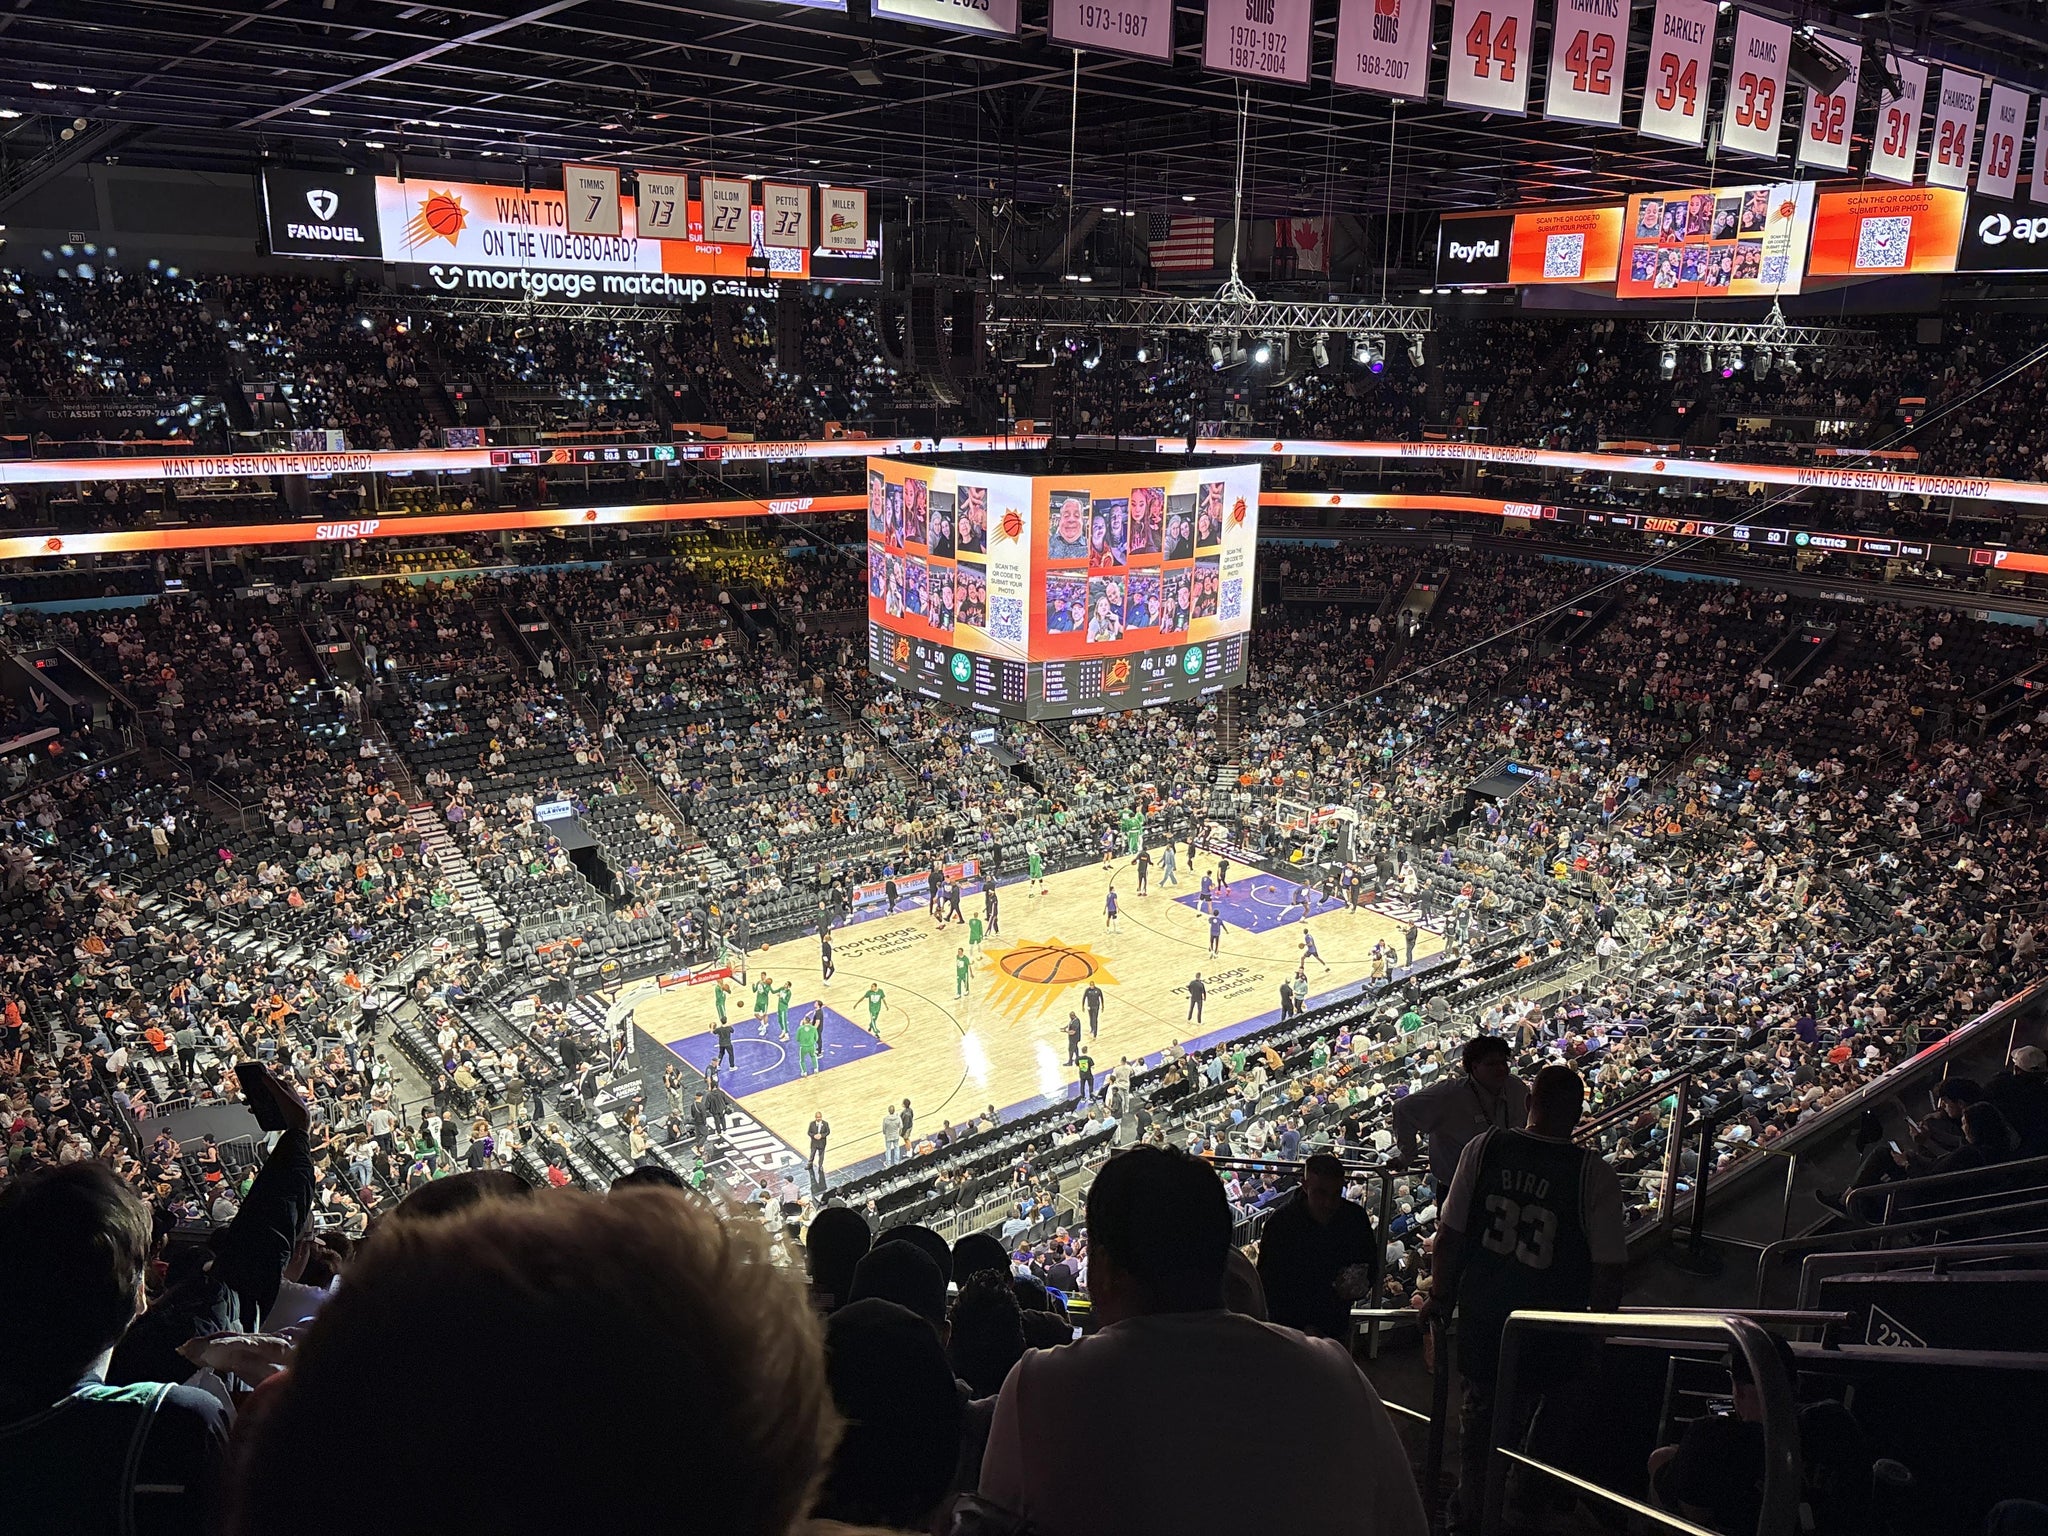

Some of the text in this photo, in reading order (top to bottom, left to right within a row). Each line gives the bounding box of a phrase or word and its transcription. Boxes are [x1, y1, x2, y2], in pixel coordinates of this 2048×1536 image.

[1078, 4, 1148, 37] 1973-1987
[1663, 13, 1706, 45] BARKLEY
[1230, 25, 1287, 54] 1970-1972
[1466, 10, 1518, 82] 44
[1748, 37, 1777, 63] ADAMS
[1229, 46, 1285, 74] 1987-2004
[1356, 52, 1409, 80] 1968-2007
[1565, 29, 1615, 95] 42
[1655, 51, 1698, 117] 34
[1735, 71, 1776, 132] 33
[1942, 88, 1975, 113] CHAMBERS
[1811, 93, 1847, 145] 32
[1999, 105, 2016, 124] NASH
[1883, 107, 1911, 159] 31
[1938, 119, 1967, 168] 24
[1987, 132, 2014, 179] 13
[579, 178, 605, 190] TIMMS
[648, 184, 675, 196] TAYLOR
[713, 190, 740, 202] GILLOM
[775, 195, 799, 207] PETTIS
[832, 199, 856, 210] MILLER
[1847, 195, 1869, 205] SCAN
[1870, 195, 1885, 204] THE
[1899, 194, 1921, 202] CODE
[1923, 193, 1934, 201] TO
[495, 197, 564, 227] WANT TO
[585, 195, 602, 222] 7
[649, 200, 675, 227] 13
[711, 206, 742, 232] 22
[1848, 203, 1929, 215] SUBMIT YOUR PHOTO
[287, 223, 365, 242] FANDUEL
[771, 210, 802, 236] 32
[483, 229, 638, 263] ON THE VIDEOBOARD?
[695, 246, 722, 255] PHOTO
[1449, 240, 1500, 263] PayPal
[467, 268, 597, 298] mortgage
[602, 273, 707, 303] matchup
[46, 410, 68, 419] TEXT
[69, 410, 102, 419] ASSIST
[104, 410, 115, 418] TO
[583, 451, 595, 461] 46
[627, 450, 638, 459] 50
[731, 443, 807, 457] ON THE VIDEOBOARD?
[1400, 444, 1538, 463] WANT TO BE SEEN ON THE VIDEOBOARD?
[162, 455, 372, 475] WANT TO BE SEEN ON THE VIDEOBOARD?
[1797, 469, 1990, 497] WANT TO BE SEEN ON THE VIDEOBOARD?
[1768, 532, 1781, 542] 50
[1810, 536, 1847, 548] CELTICS
[247, 588, 264, 597] Bell
[1819, 590, 1860, 602] Bell Bank
[916, 646, 926, 659] 46
[934, 651, 945, 665] 50
[1140, 657, 1153, 670] 46
[1165, 653, 1177, 667] 50
[832, 926, 918, 953] mortgage
[865, 932, 929, 953] matchup
[878, 943, 914, 956] center
[1207, 974, 1265, 996] matchup
[1223, 986, 1255, 1000] center
[615, 1085, 642, 1098] AMERICA
[1501, 1169, 1550, 1199] BIRD
[1482, 1194, 1557, 1270] 33
[1876, 1323, 1912, 1348] 22
